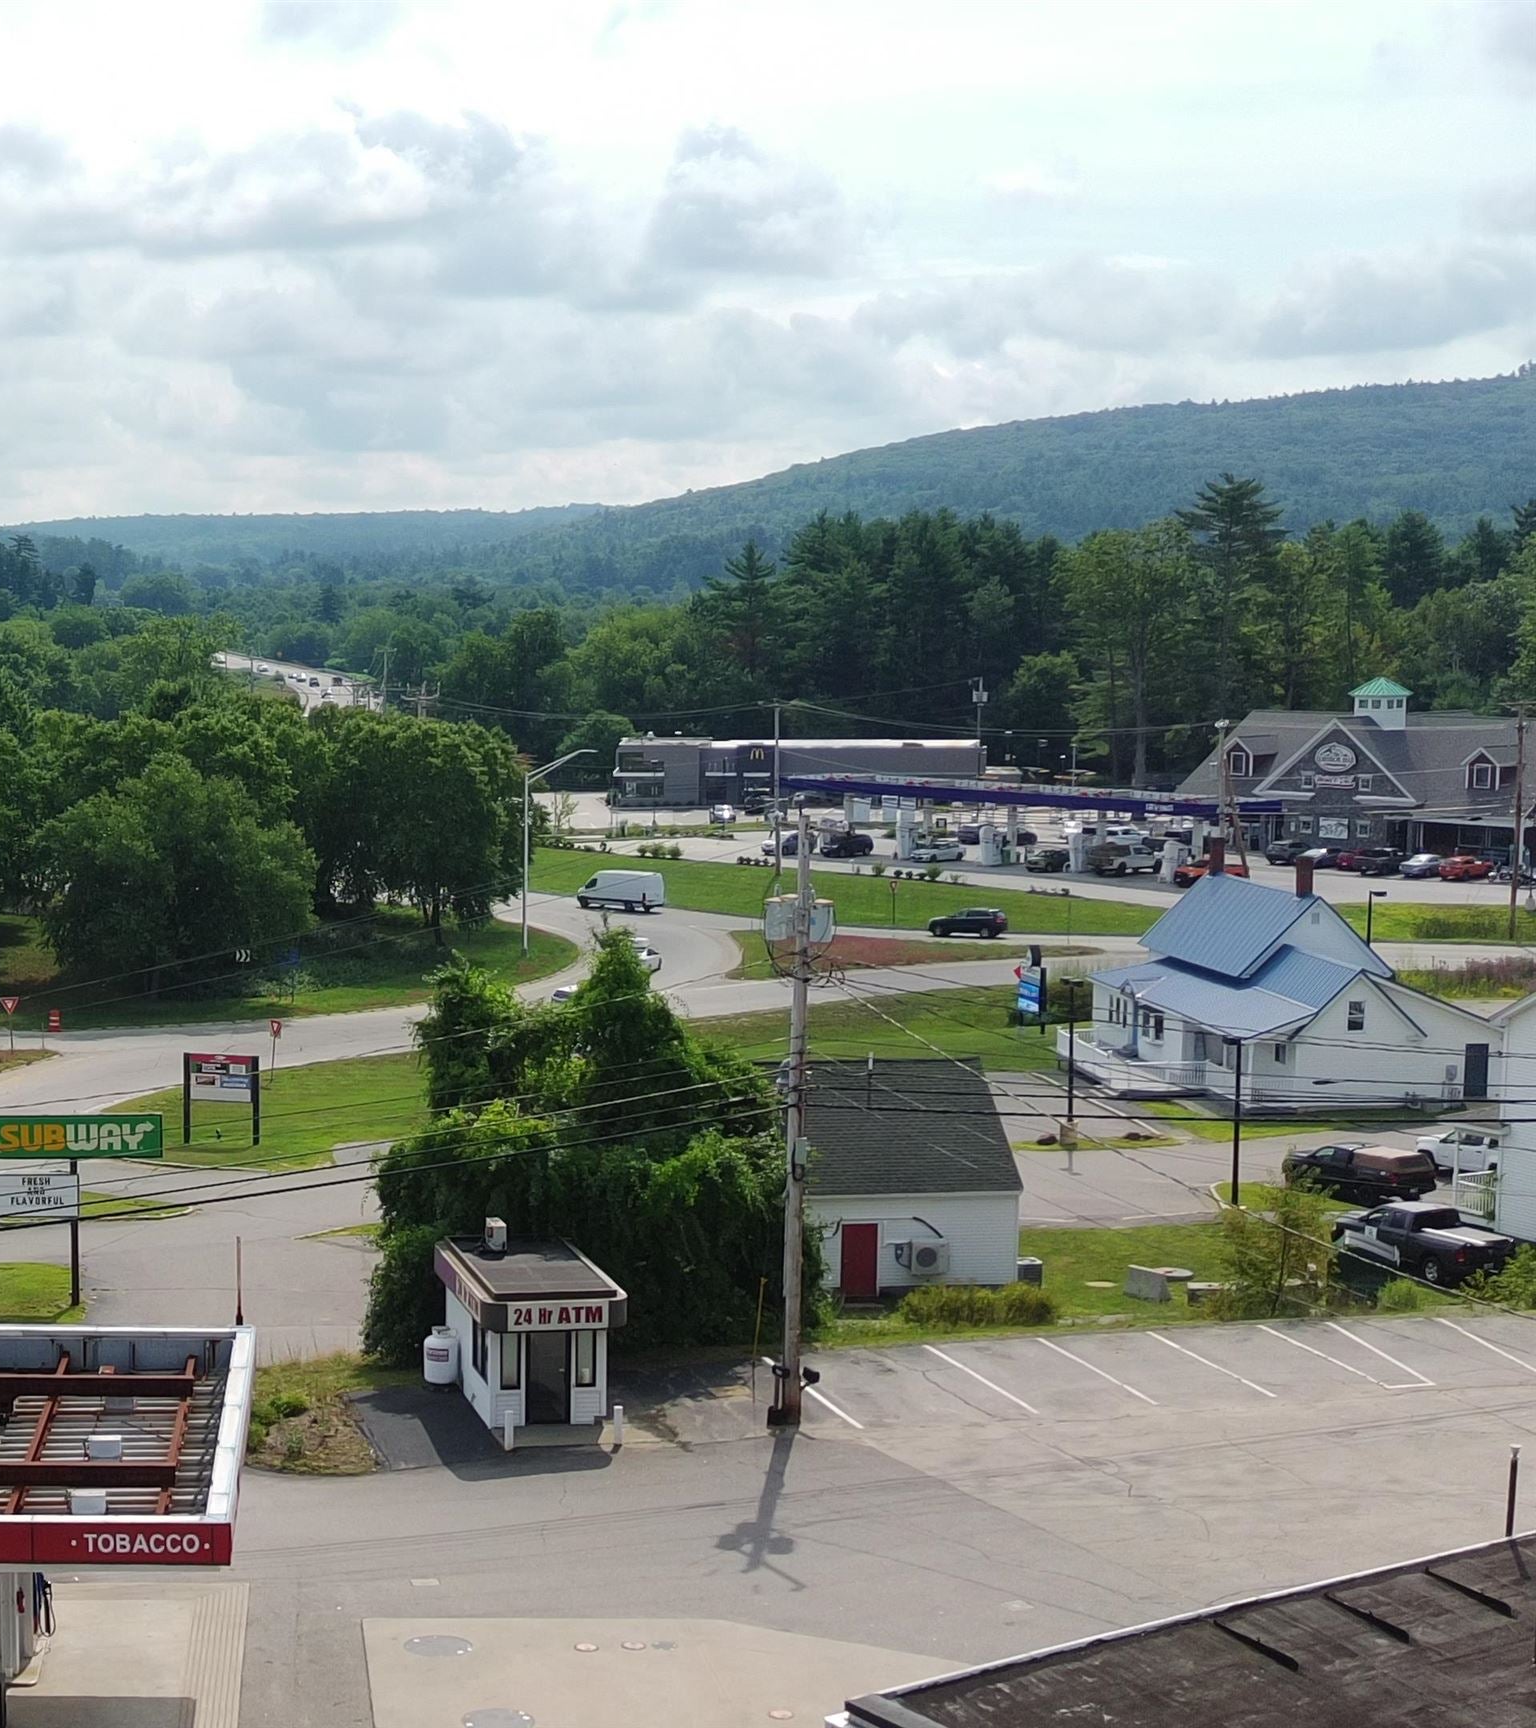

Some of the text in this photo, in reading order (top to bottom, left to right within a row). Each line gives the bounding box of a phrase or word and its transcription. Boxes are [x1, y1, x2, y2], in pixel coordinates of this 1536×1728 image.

[21, 1177, 51, 1186] FRESH
[10, 1196, 65, 1206] FLAVORFUL
[513, 1305, 603, 1326] 24 Hr ATM
[83, 1533, 200, 1553] TOBACCO
